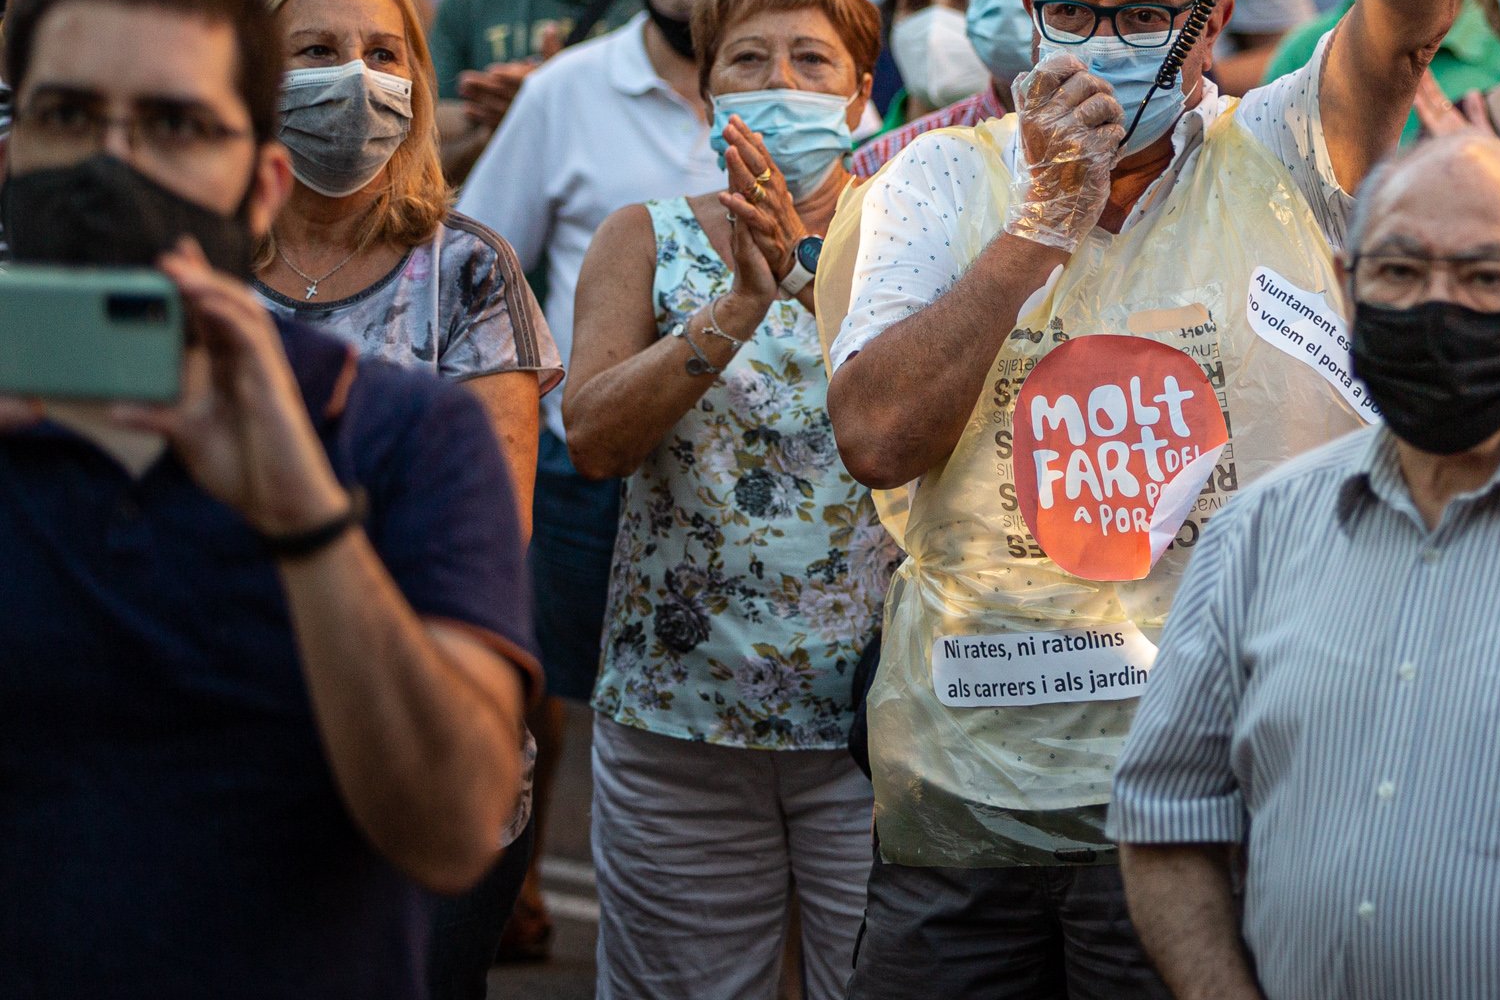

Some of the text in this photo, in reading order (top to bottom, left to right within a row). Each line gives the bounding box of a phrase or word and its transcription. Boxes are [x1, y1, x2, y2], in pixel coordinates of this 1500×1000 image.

[1256, 273, 1337, 337] Ajuntament
[1261, 310, 1304, 345] volem
[1306, 342, 1322, 357] el
[1318, 353, 1353, 389] porta
[1353, 386, 1362, 398] a
[1073, 506, 1092, 524] A
[944, 631, 1124, 661] Ni rates, ni ratolins
[948, 666, 1150, 698] als carrers i als jardin
